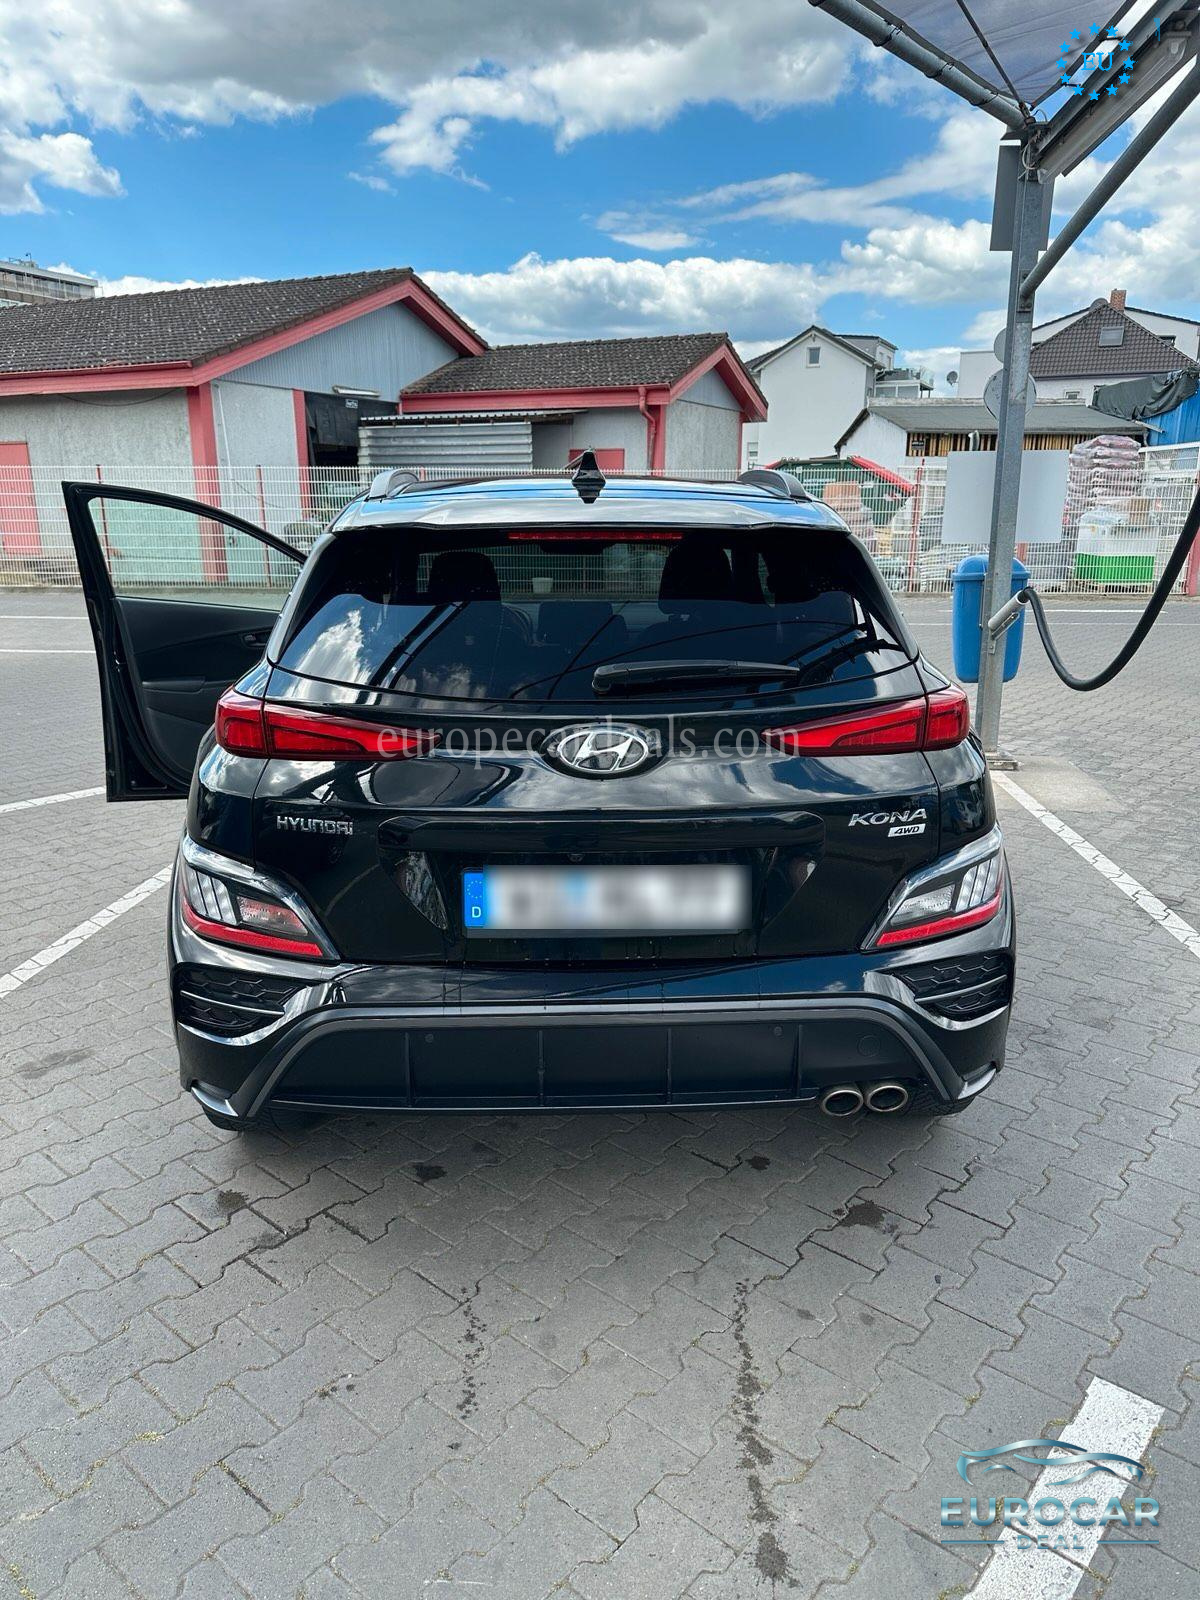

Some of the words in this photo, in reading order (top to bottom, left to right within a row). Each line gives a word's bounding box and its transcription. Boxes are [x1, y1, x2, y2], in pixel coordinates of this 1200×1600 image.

[848, 808, 927, 827] KONA
[276, 815, 354, 836] HYUNDAI
[893, 825, 921, 836] 4WD
[471, 906, 482, 918] D
